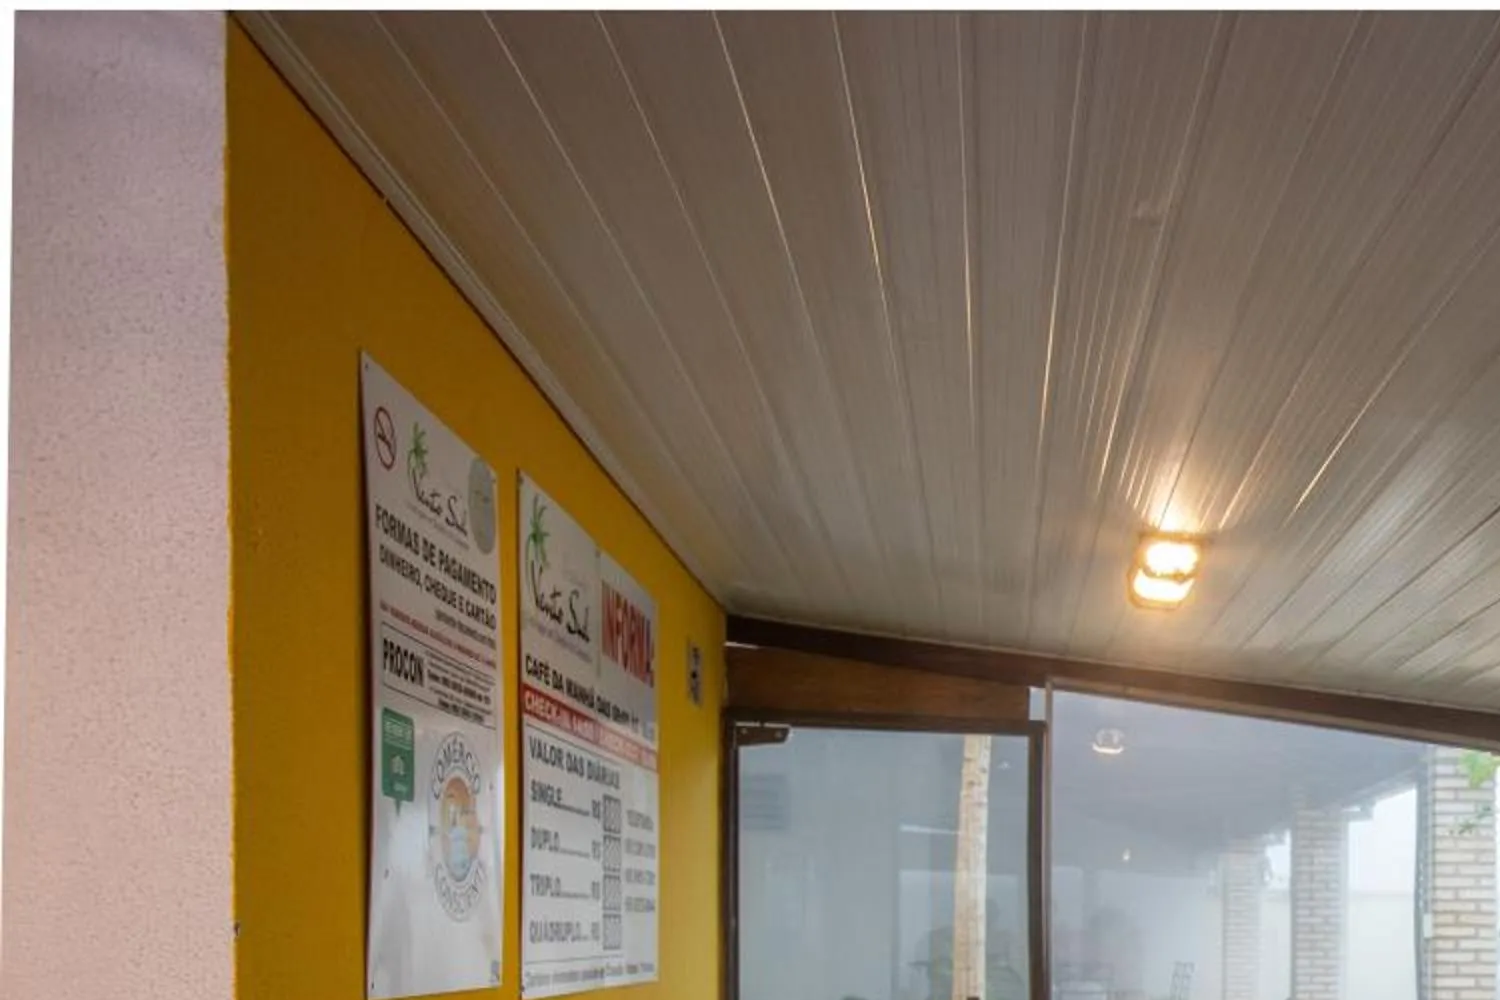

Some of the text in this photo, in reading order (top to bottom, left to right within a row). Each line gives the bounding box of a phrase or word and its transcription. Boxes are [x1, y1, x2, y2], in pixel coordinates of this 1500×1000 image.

[376, 503, 420, 556] FORMAS
[422, 537, 436, 568] DE
[438, 549, 497, 605] PAGAMENTO
[379, 543, 422, 592] DINHEIRO,
[424, 573, 457, 609] CHEQUE
[459, 594, 465, 614] E
[566, 588, 590, 643] Sul
[383, 638, 424, 688] PROCON
[525, 653, 551, 687] CAFÉ
[551, 669, 564, 693] DA
[529, 736, 564, 770] VALOR
[566, 751, 584, 778] DAS
